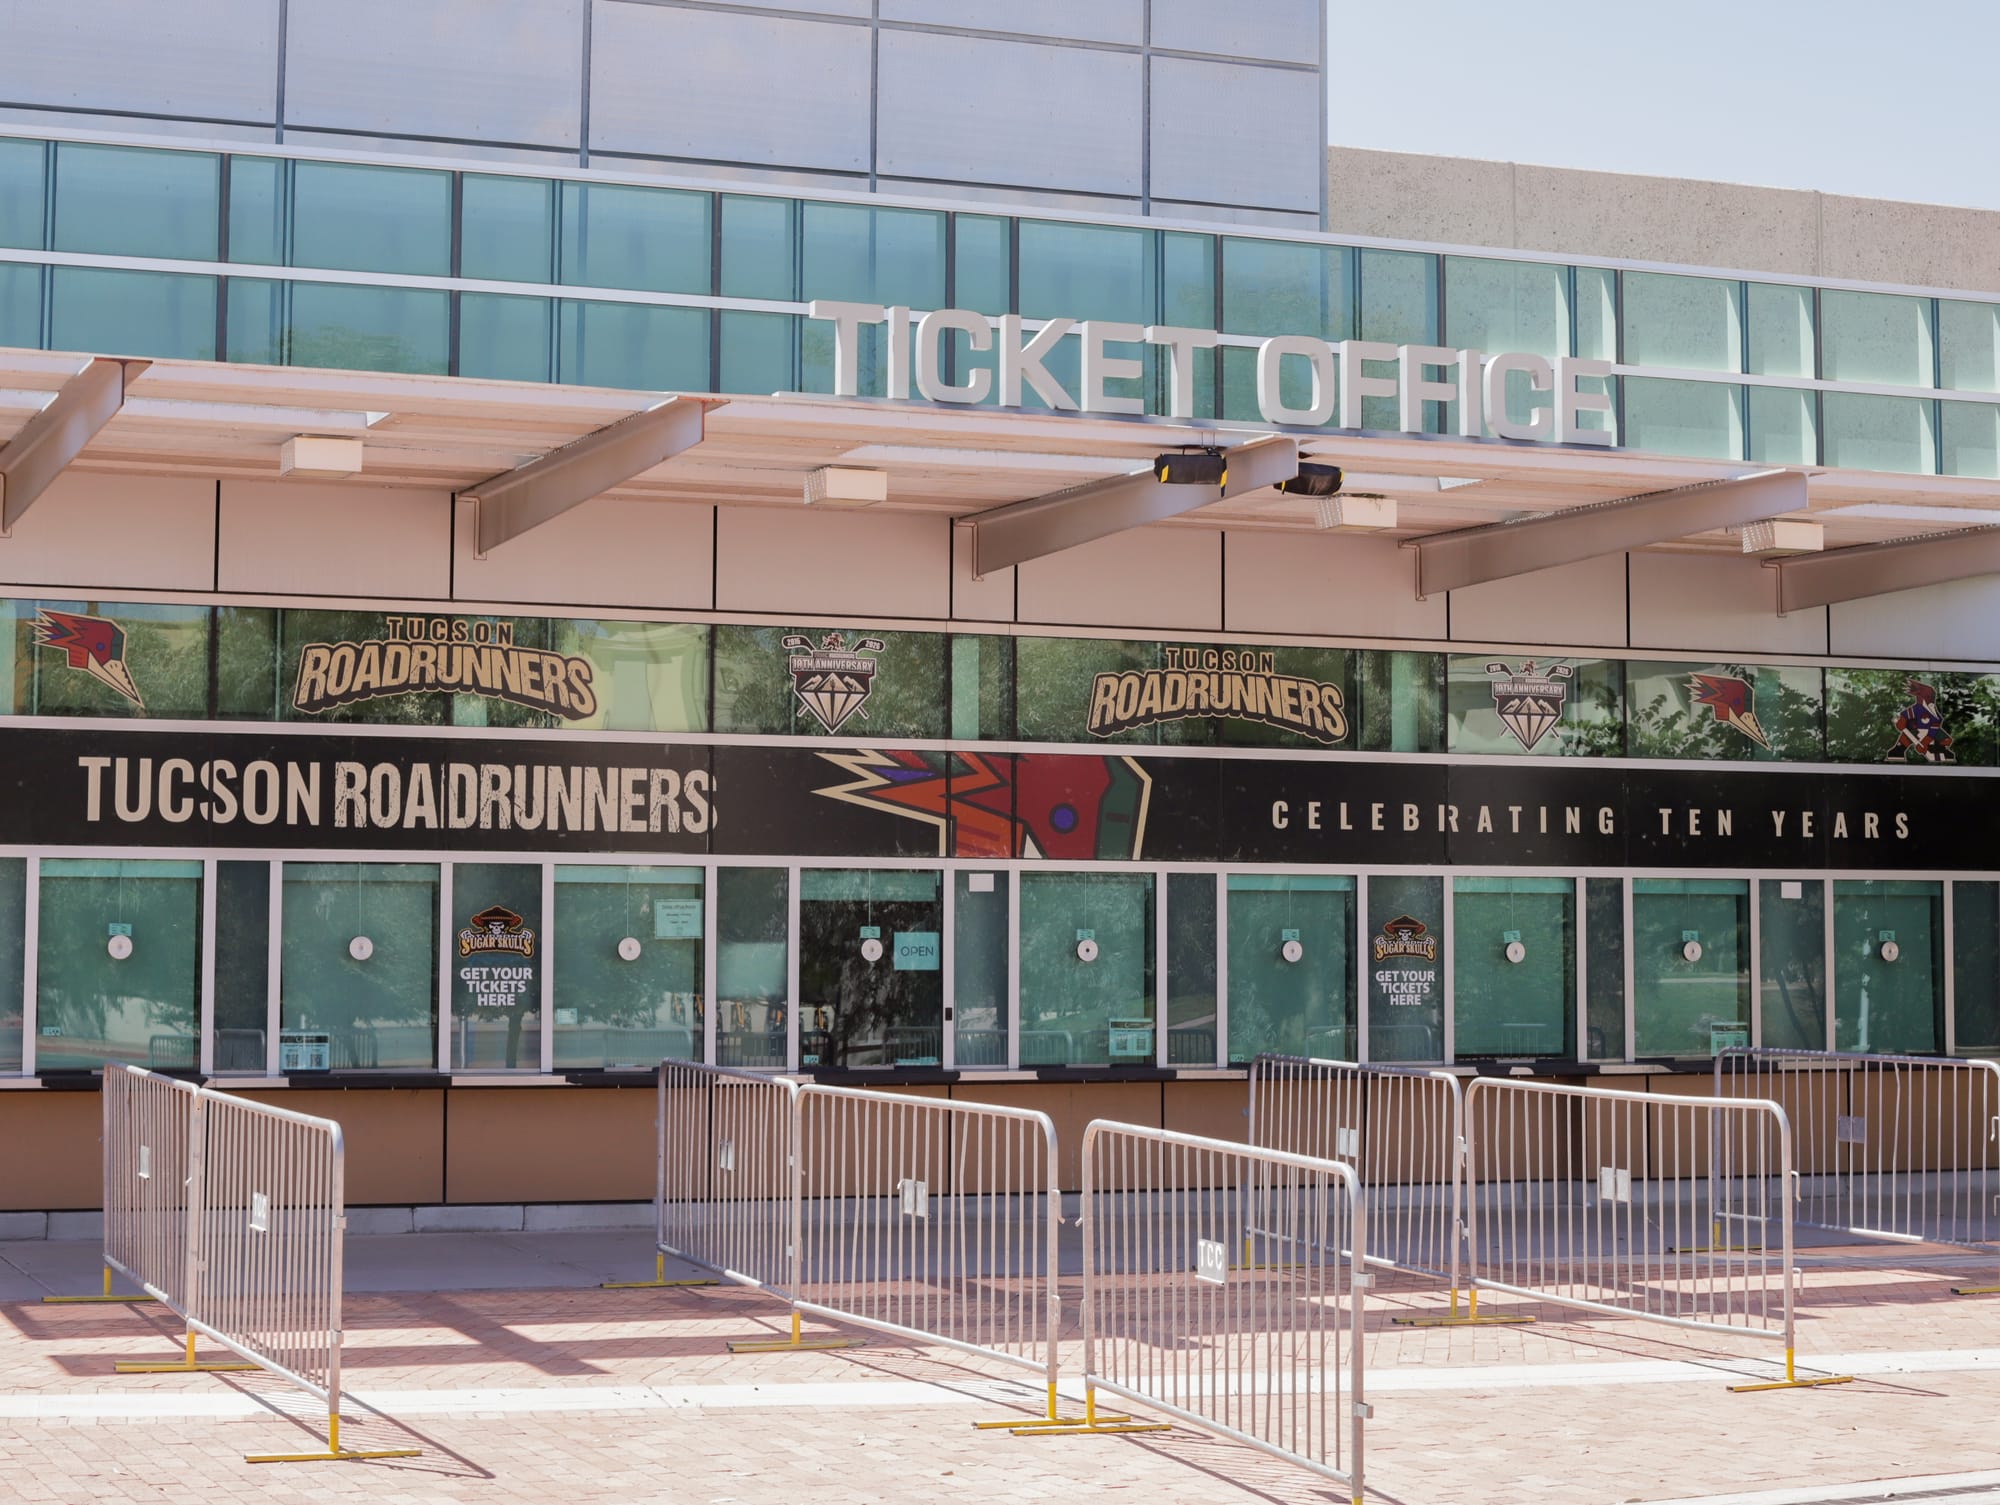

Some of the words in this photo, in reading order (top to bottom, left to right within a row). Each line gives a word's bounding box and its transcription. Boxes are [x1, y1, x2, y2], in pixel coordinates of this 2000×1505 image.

[809, 300, 1218, 418] TICKET
[1258, 335, 1614, 447] OFFICE
[386, 617, 513, 645] TUCSON
[815, 660, 873, 673] ANNIVERSARY
[1166, 648, 1274, 675] TUCSON
[295, 641, 597, 718] ROADRUNNERS
[1513, 683, 1564, 695] ANNIVERSARY
[1088, 670, 1347, 741] ROADRUNNERS
[78, 756, 321, 826] TUCSON
[334, 761, 718, 834] ROADRUNNERS
[1271, 800, 1615, 834] CELEBRATING
[1659, 808, 1732, 836] TEN
[1771, 810, 1909, 839] YEARS
[461, 936, 496, 955] SUGAR
[497, 936, 532, 955] SKULLS
[900, 945, 934, 957] OPEN
[1376, 943, 1404, 958] SUGAR
[1406, 943, 1434, 958] SKULLS
[460, 967, 489, 980] GET
[491, 967, 533, 980] YOUR
[1376, 971, 1399, 981] GET
[1401, 971, 1435, 981] YOUR
[466, 981, 526, 993] TICKETS
[1381, 982, 1430, 993] TICKETS
[477, 994, 515, 1006] HERE
[1390, 994, 1421, 1005] HERE
[1199, 1240, 1223, 1271] TCC
